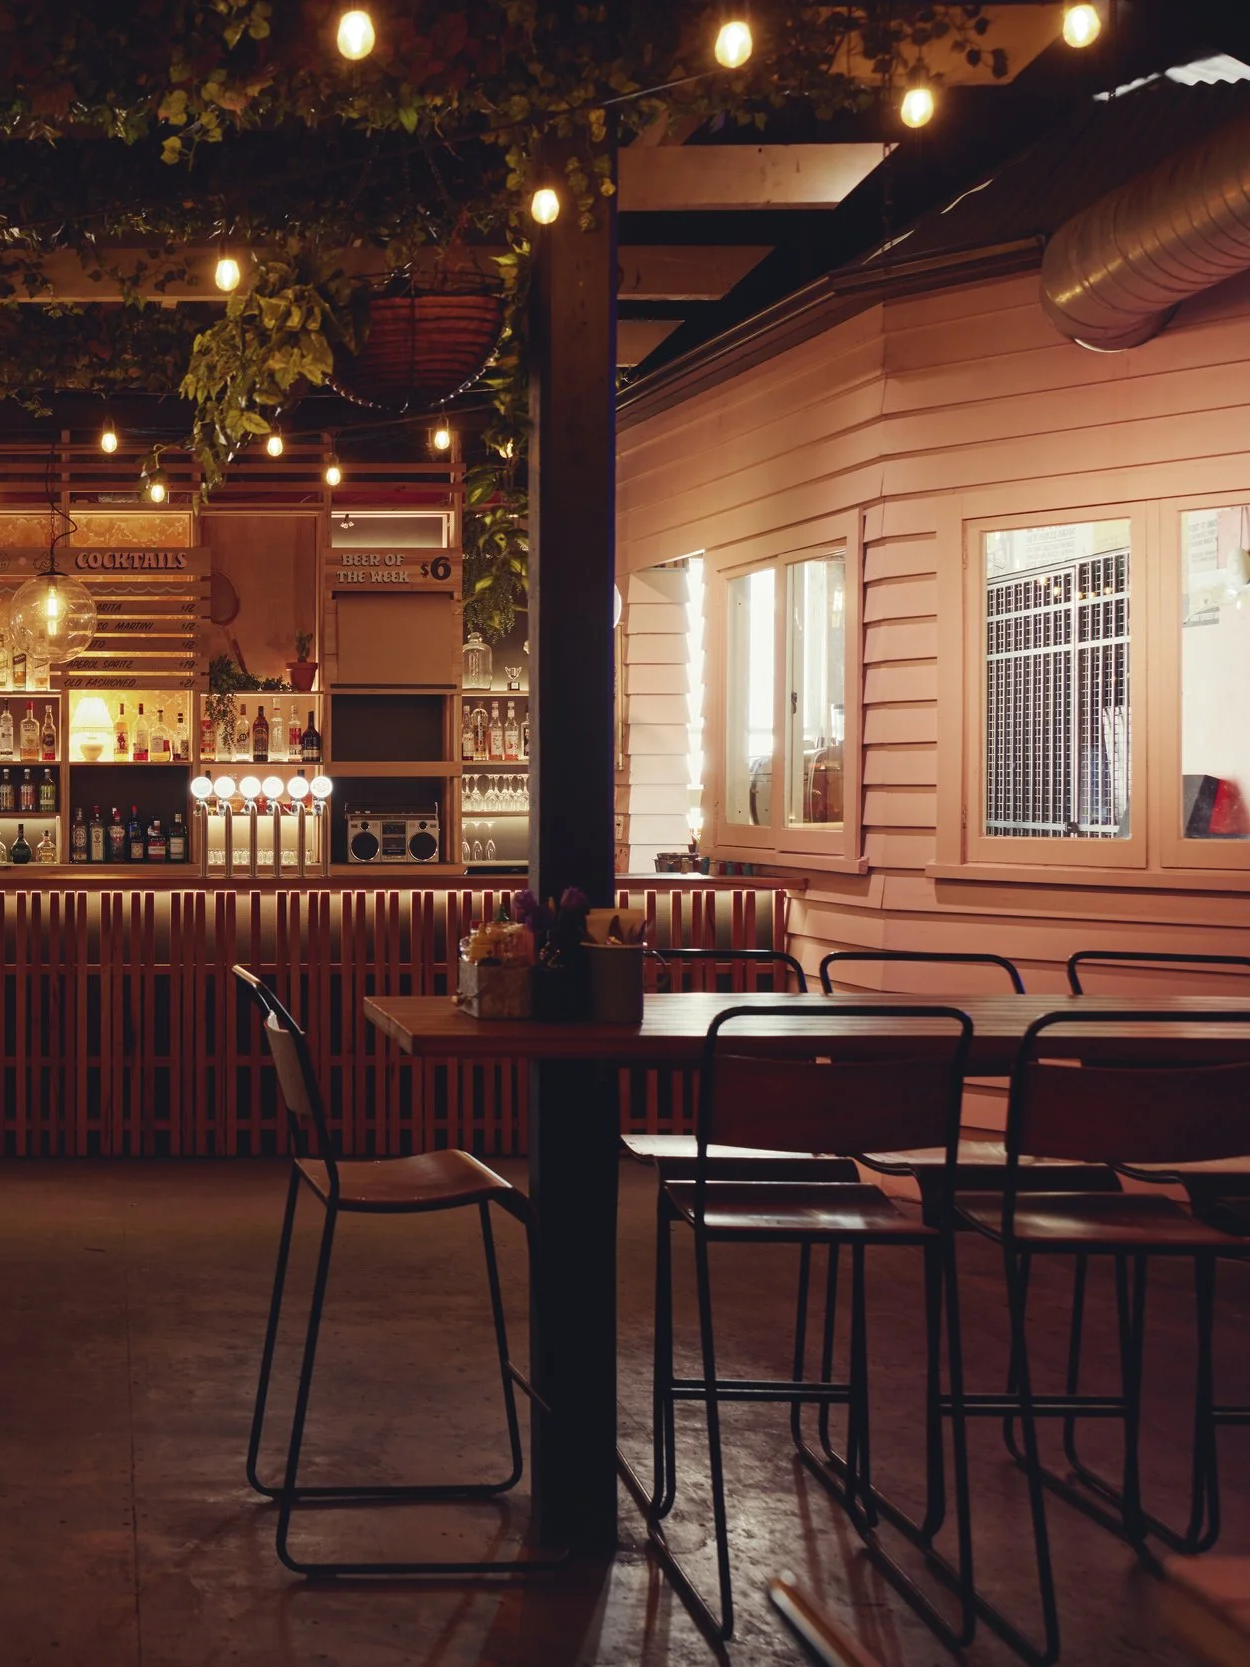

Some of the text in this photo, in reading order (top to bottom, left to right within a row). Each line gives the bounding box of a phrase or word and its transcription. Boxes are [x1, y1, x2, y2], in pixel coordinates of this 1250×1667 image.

[75, 552, 187, 570] COCKTAILS
[341, 554, 405, 567] BEER OF
[420, 556, 451, 581] $6
[336, 571, 410, 584] THE WEEK
[115, 622, 154, 631] MARTINI
[66, 660, 98, 669] APEROL
[102, 660, 134, 669] SPRITZ
[64, 678, 82, 688] OLD
[85, 678, 137, 688] FASHIONED
